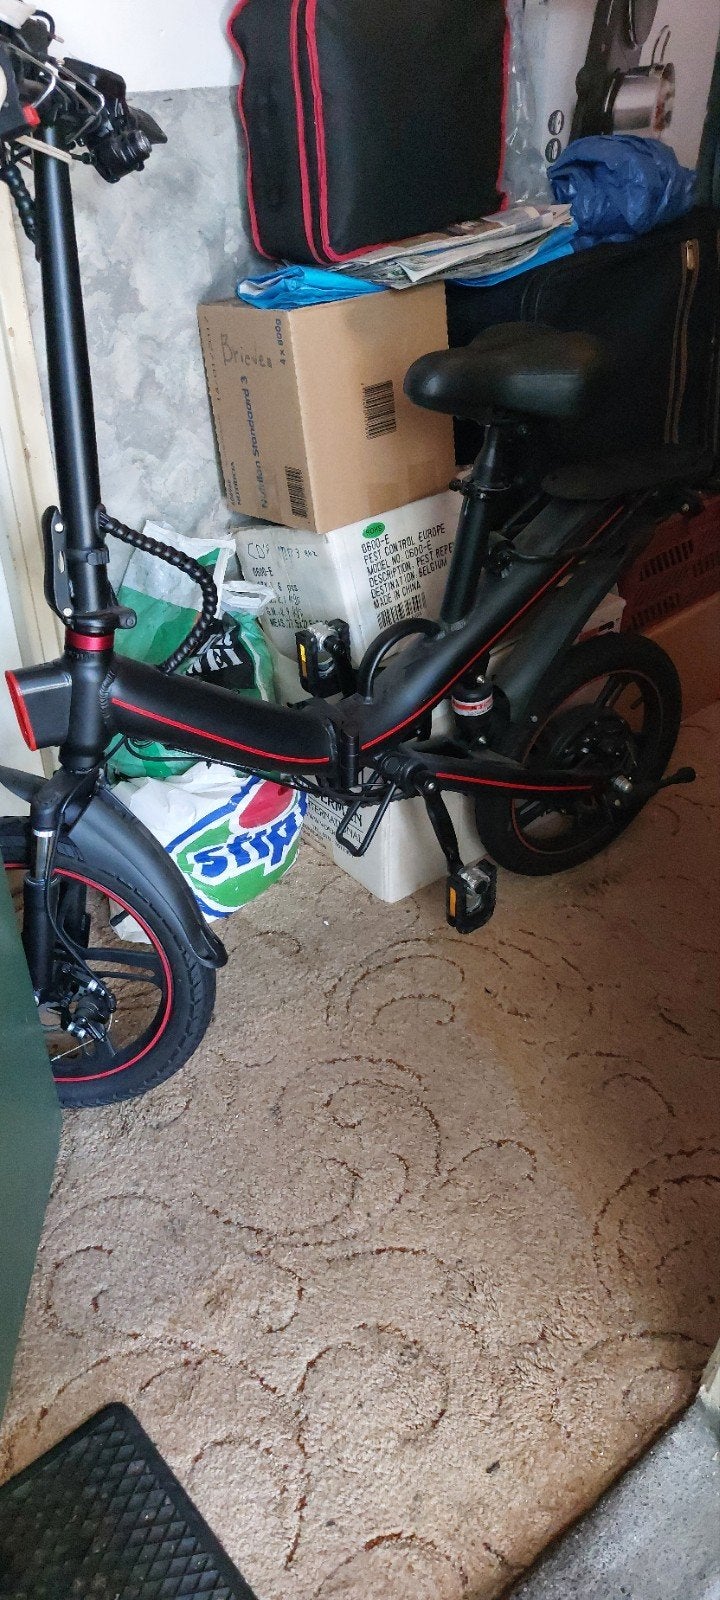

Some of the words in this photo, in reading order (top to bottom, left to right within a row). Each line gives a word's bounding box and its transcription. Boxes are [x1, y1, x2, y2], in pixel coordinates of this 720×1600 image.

[275, 318, 284, 346] 800g
[240, 375, 248, 384] 3
[241, 387, 261, 457] Standaard
[361, 534, 390, 554] 0600-E
[364, 549, 382, 566] PEST
[384, 536, 416, 557] CONTROL
[418, 523, 446, 542] EUROPE
[366, 559, 390, 576] MODEL
[405, 541, 433, 560] 0600-E
[416, 551, 434, 568] PEST
[419, 558, 447, 577] BELGIUM
[373, 593, 392, 609] MADE
[394, 588, 401, 599] IN
[402, 580, 422, 598] CHINA
